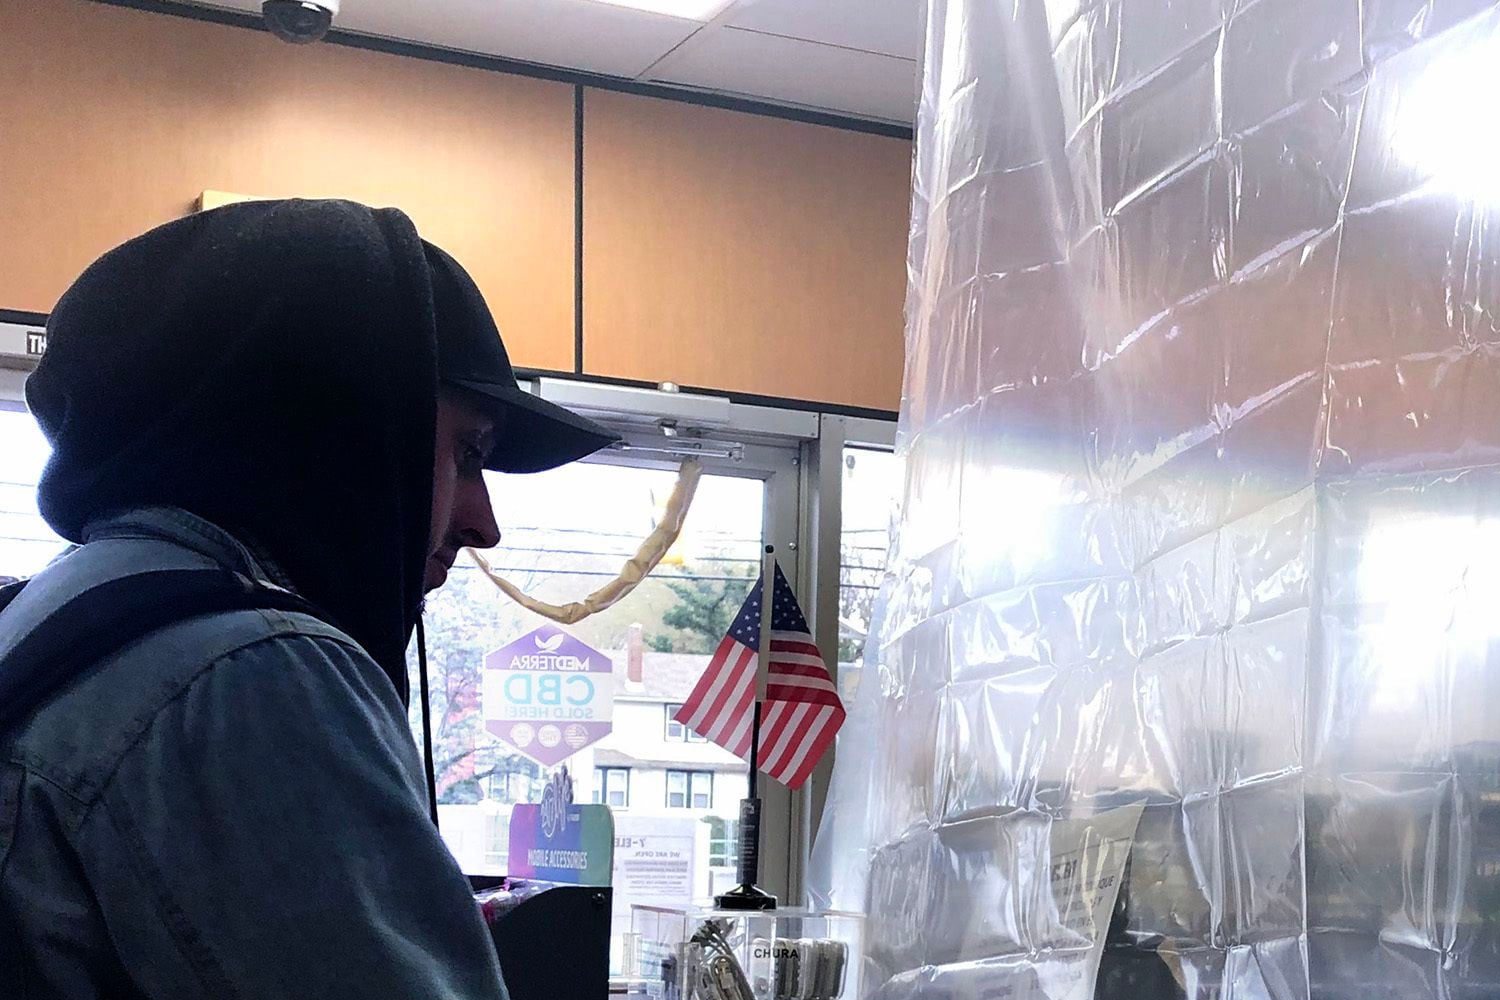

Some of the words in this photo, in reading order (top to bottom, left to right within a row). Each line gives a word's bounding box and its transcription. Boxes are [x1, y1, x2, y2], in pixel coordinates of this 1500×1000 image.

[528, 849, 549, 867] MOBILE
[549, 850, 587, 870] ACCESSORIES
[754, 949, 799, 959] CHURA
